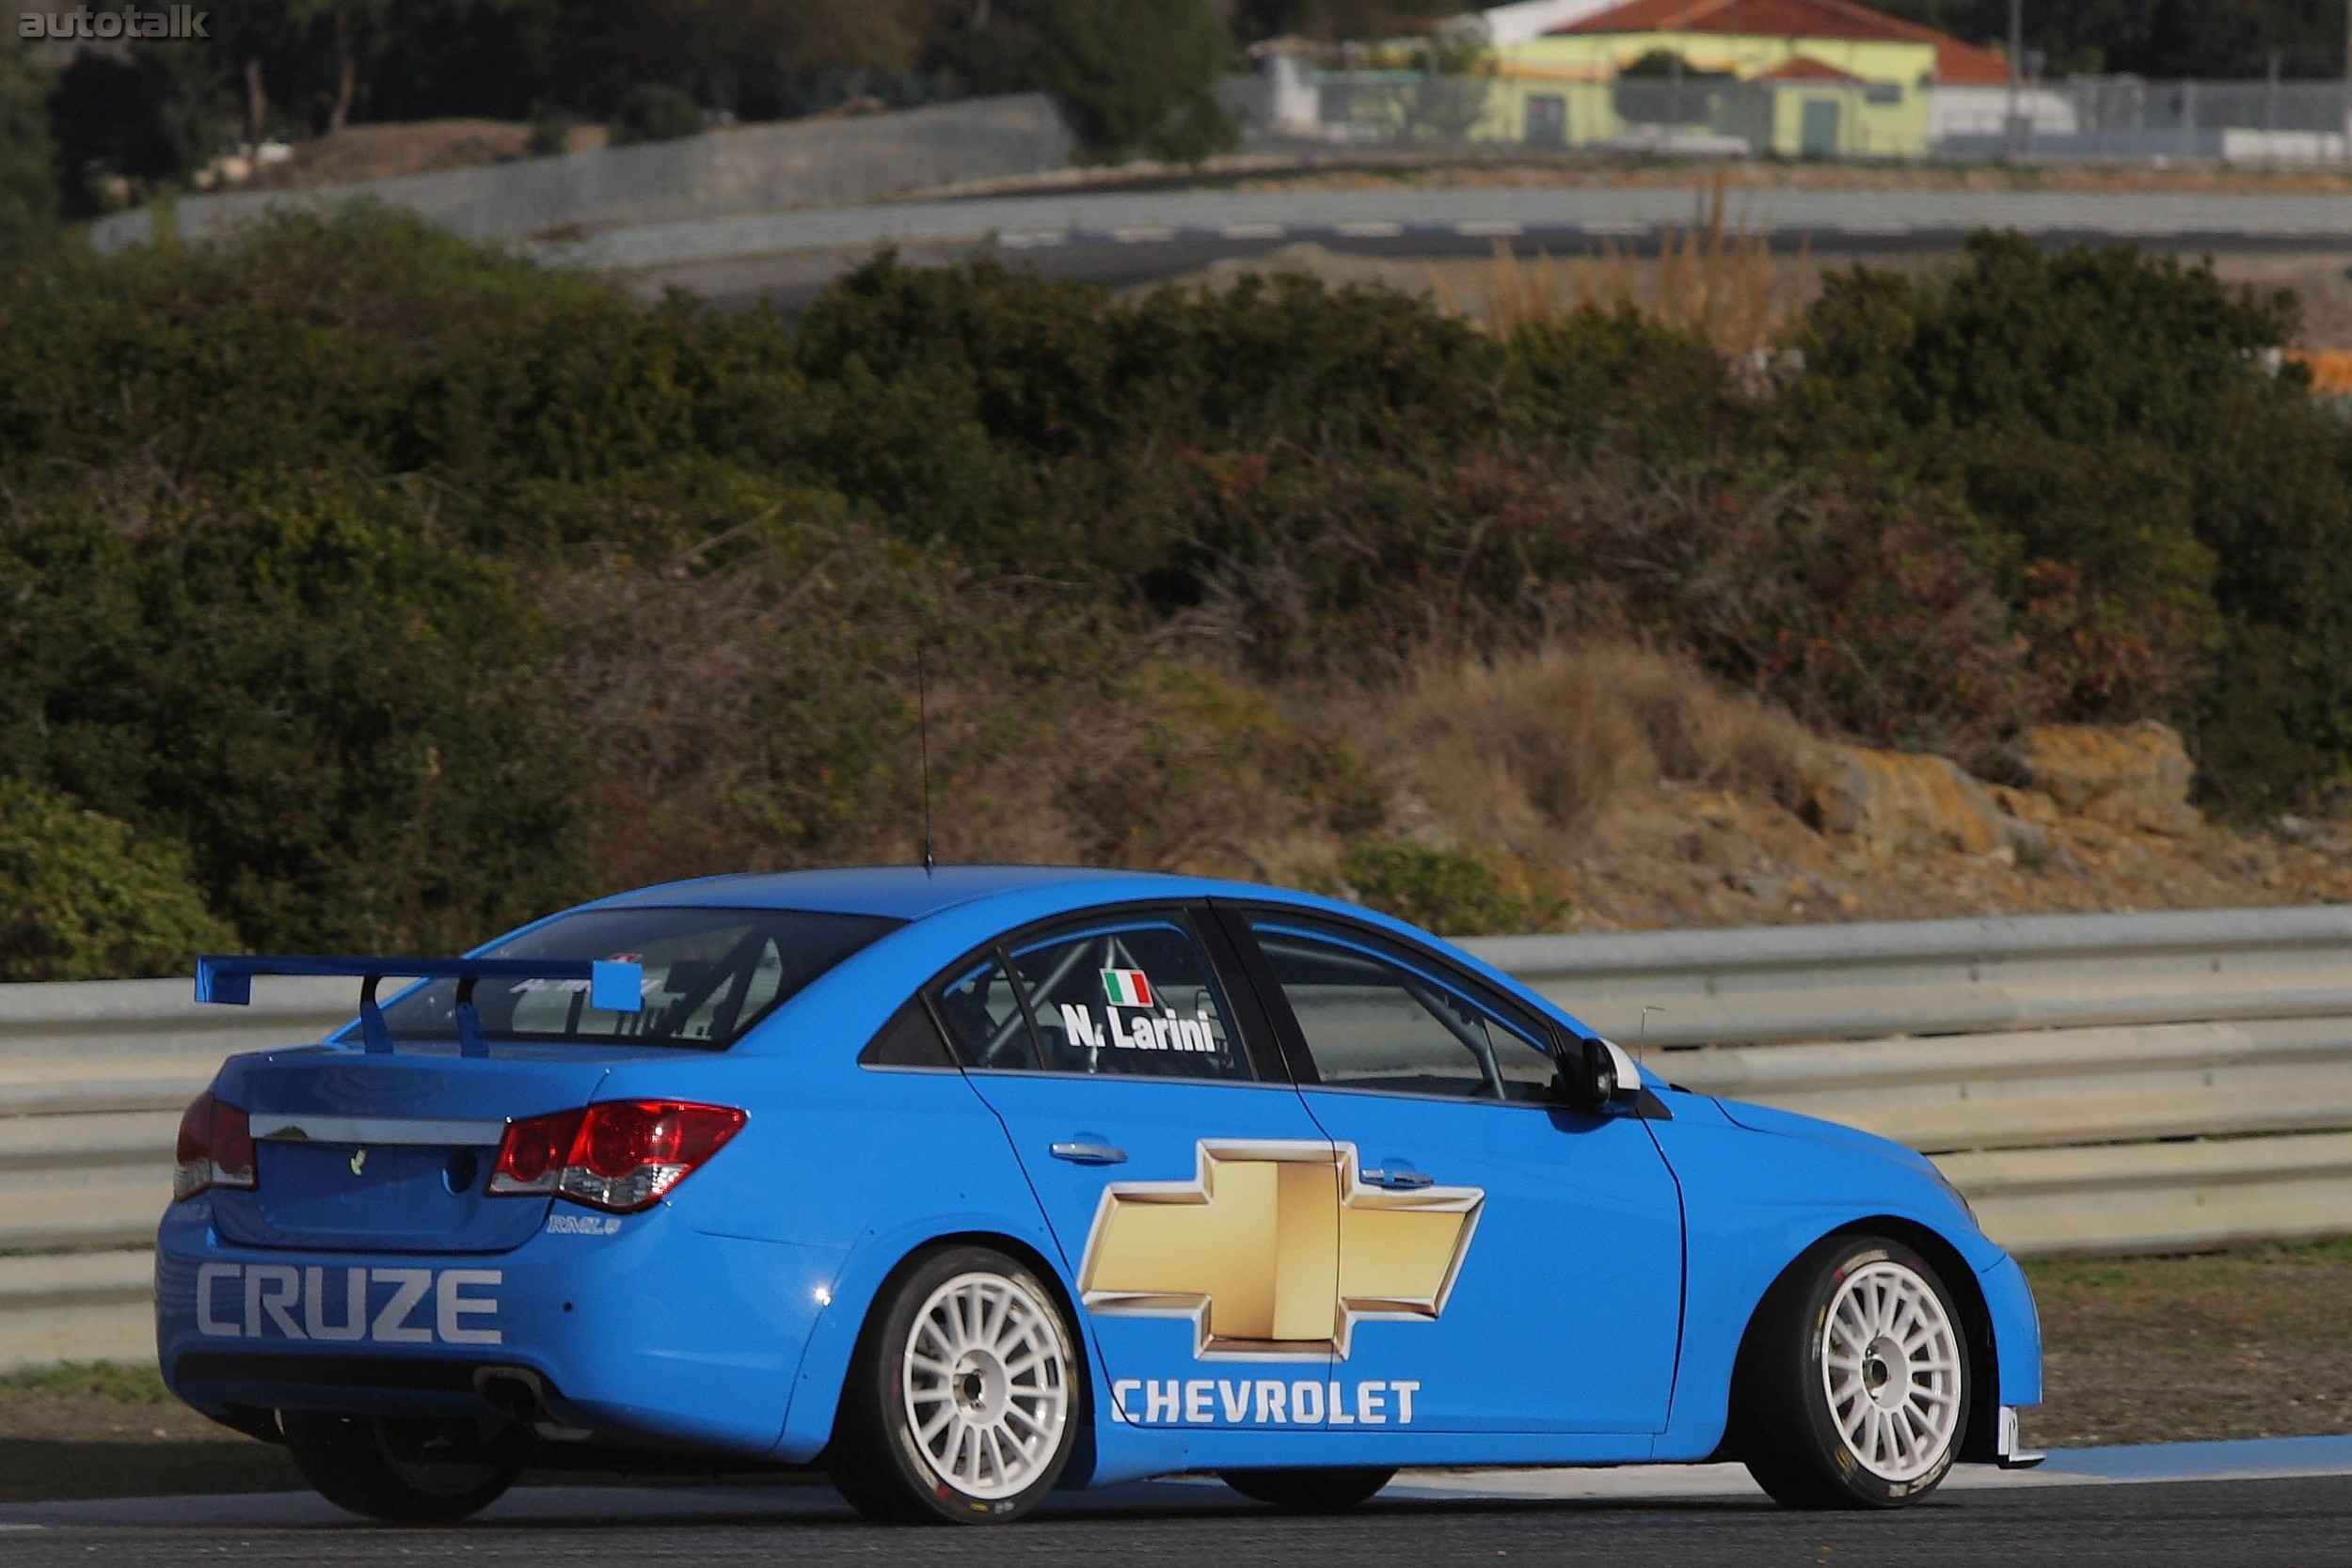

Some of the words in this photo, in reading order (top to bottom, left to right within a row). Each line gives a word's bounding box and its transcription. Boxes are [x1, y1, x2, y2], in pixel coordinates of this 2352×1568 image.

[1060, 1003, 1105, 1048] N.
[1105, 1005, 1216, 1053] Larini
[196, 1262, 502, 1345] CRUZE
[1111, 1379, 1421, 1424] CHEVROLET
